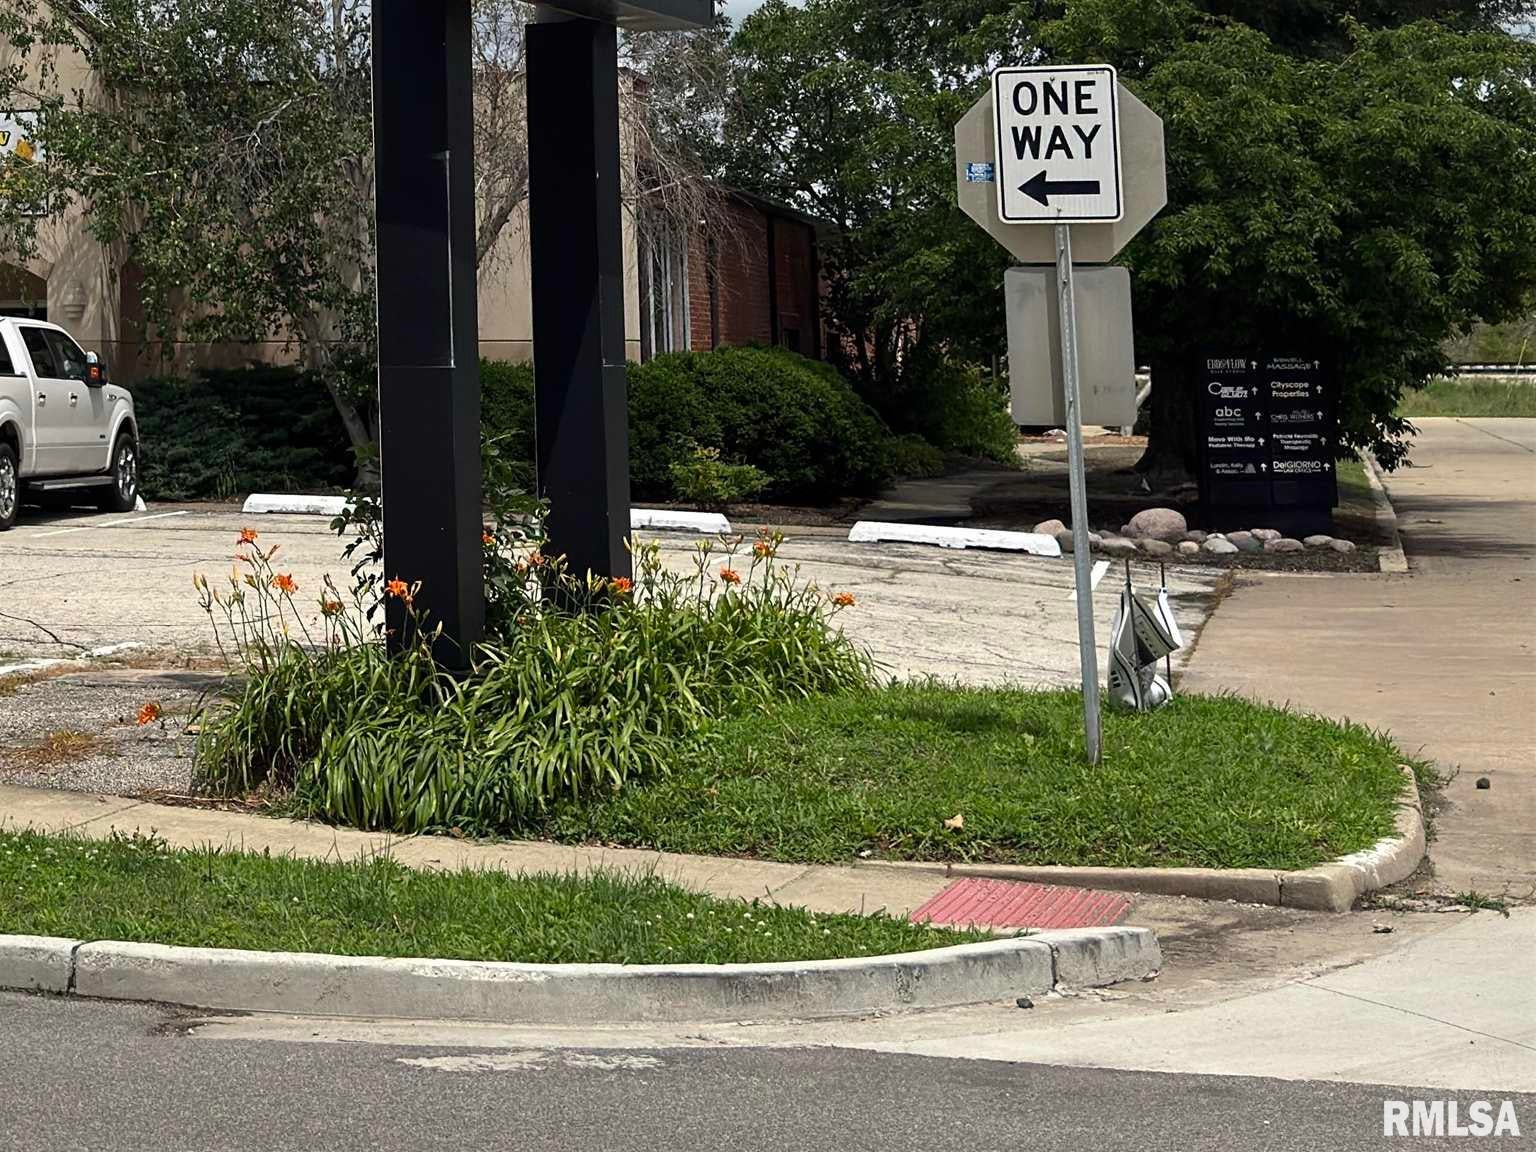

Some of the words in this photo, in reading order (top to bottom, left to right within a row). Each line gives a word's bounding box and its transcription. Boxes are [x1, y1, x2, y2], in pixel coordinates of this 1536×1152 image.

[1012, 80, 1098, 115] ONE
[1011, 124, 1101, 160] WAY
[1215, 405, 1242, 417] abc
